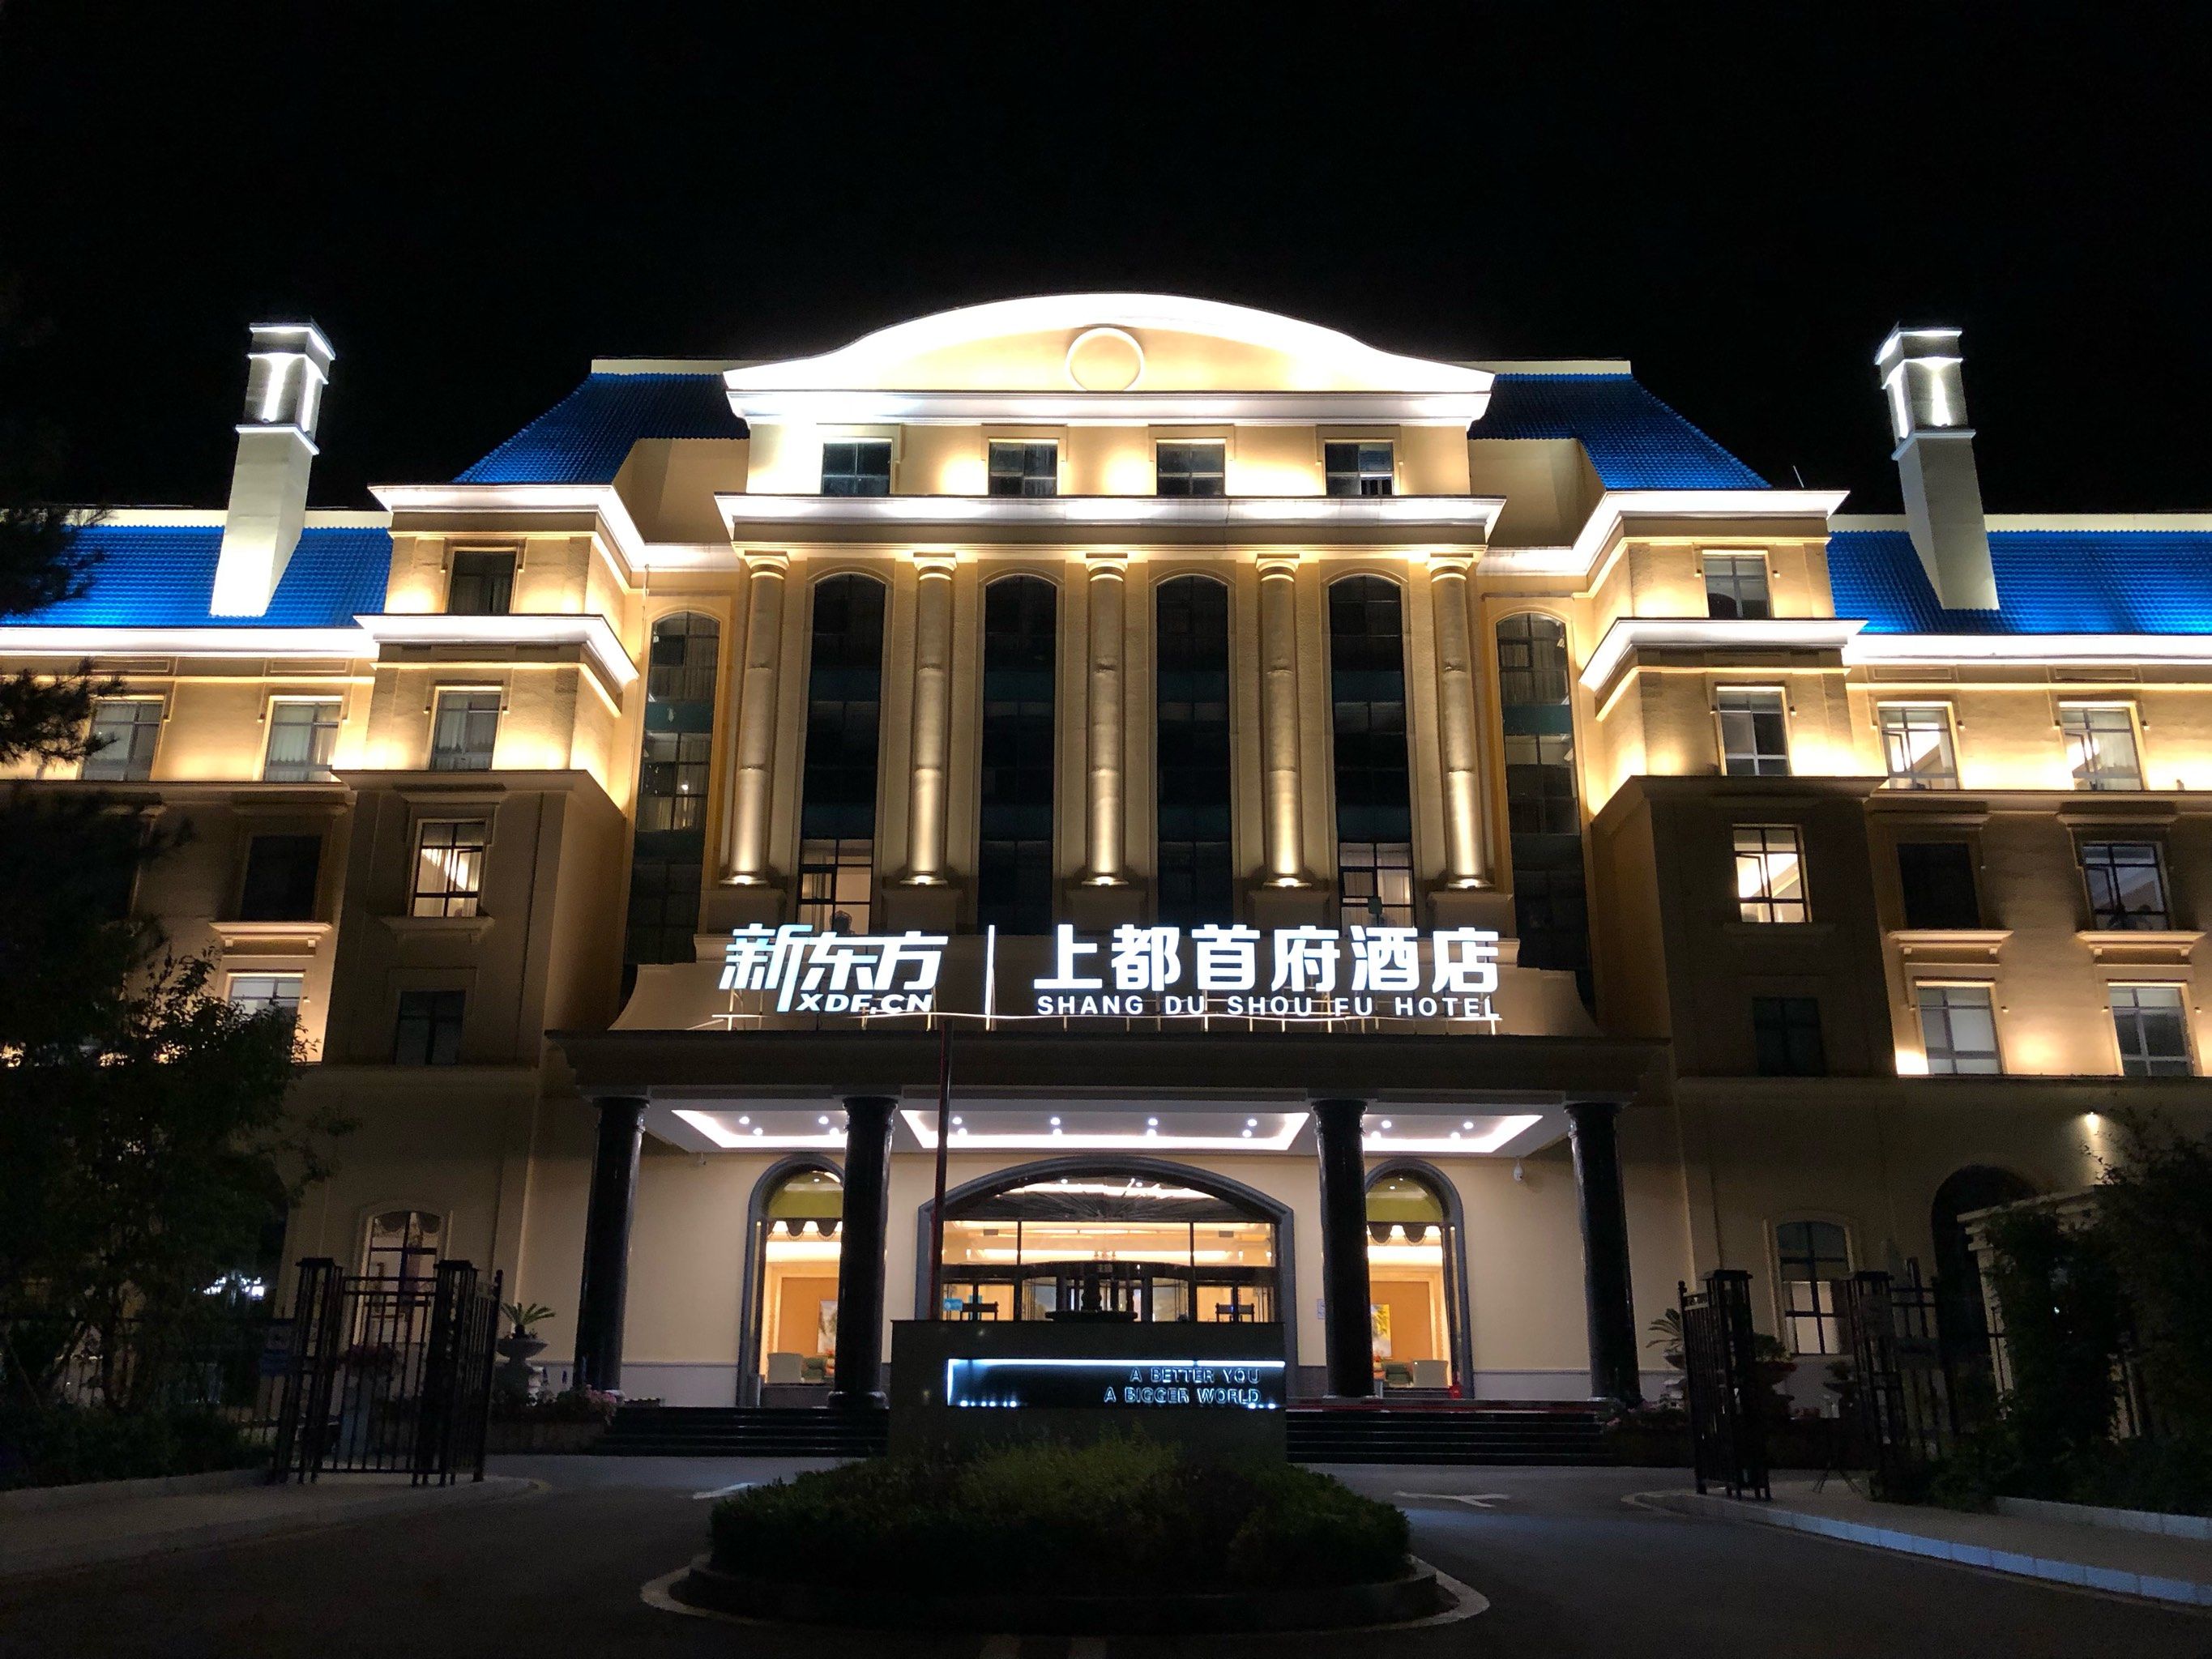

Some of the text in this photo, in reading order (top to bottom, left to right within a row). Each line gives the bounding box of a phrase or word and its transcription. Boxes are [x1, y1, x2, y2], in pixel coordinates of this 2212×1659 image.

[719, 923, 949, 1012] 新东方
[1033, 923, 1500, 993] 上都首府酒店
[796, 993, 933, 1014] XDF.CN
[1037, 995, 1499, 1018] SHANG DU SHOU FU HOTEL
[1130, 1367, 1261, 1384] A BETTER YOU
[1104, 1387, 1262, 1405] A BIGGER WORLD
